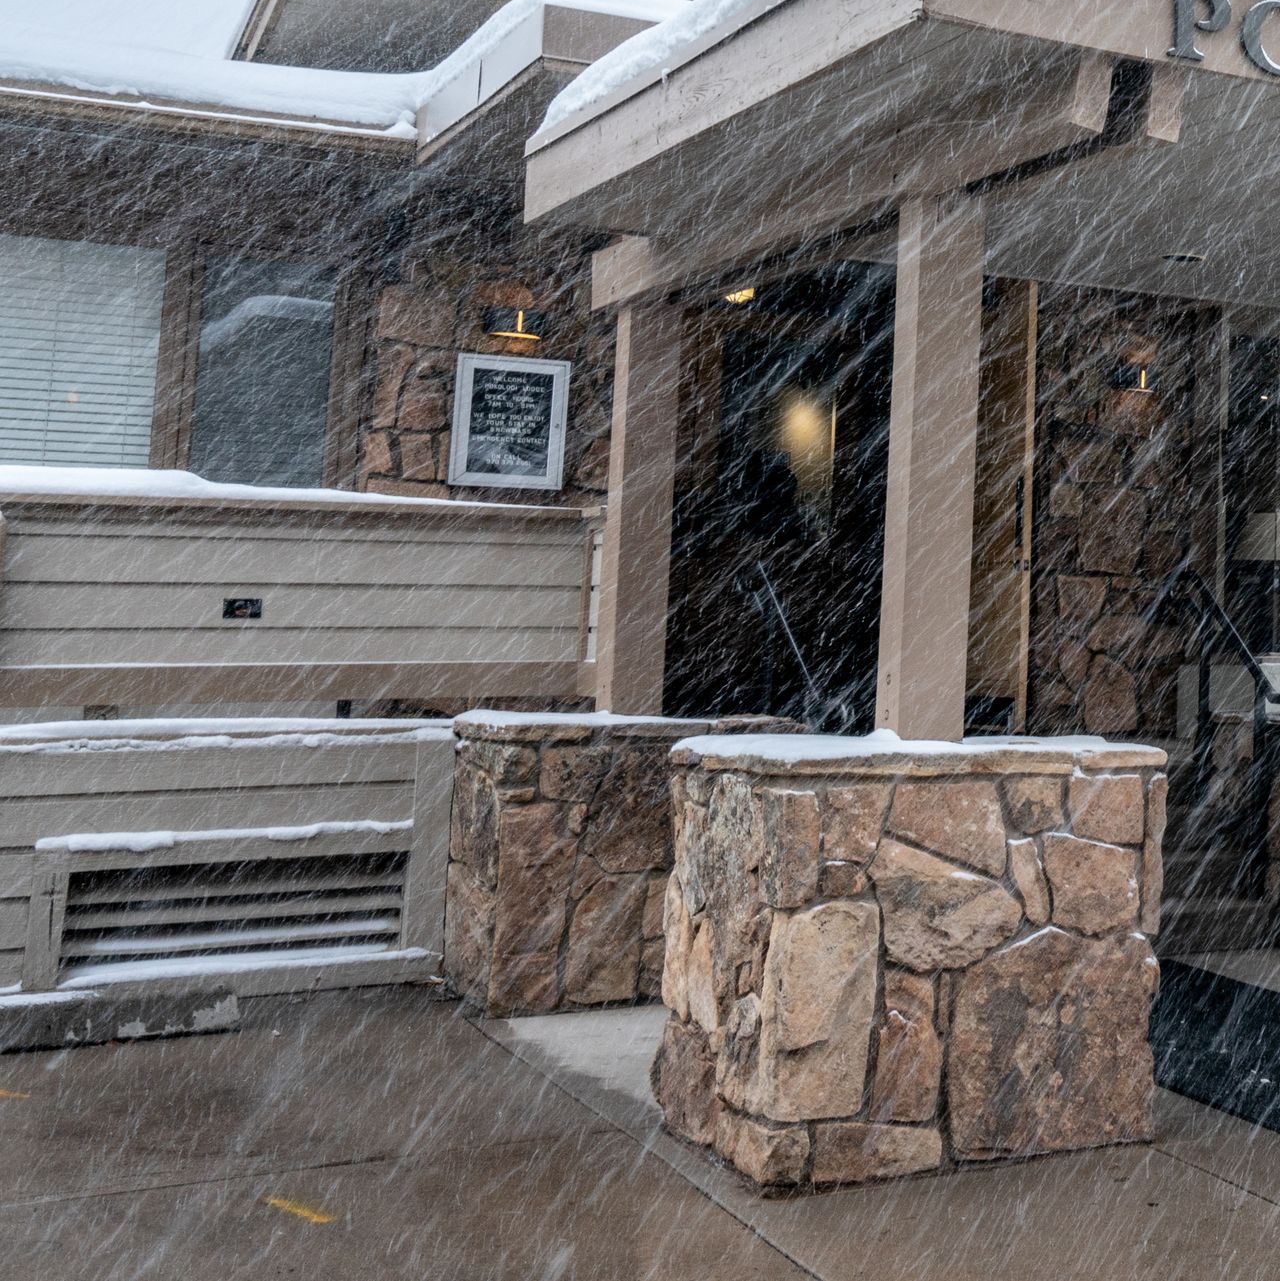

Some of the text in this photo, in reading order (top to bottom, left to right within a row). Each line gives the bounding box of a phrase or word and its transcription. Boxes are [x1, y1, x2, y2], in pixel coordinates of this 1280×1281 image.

[493, 376, 527, 384] WELCOME
[484, 393, 534, 403] OFFICE HOURS
